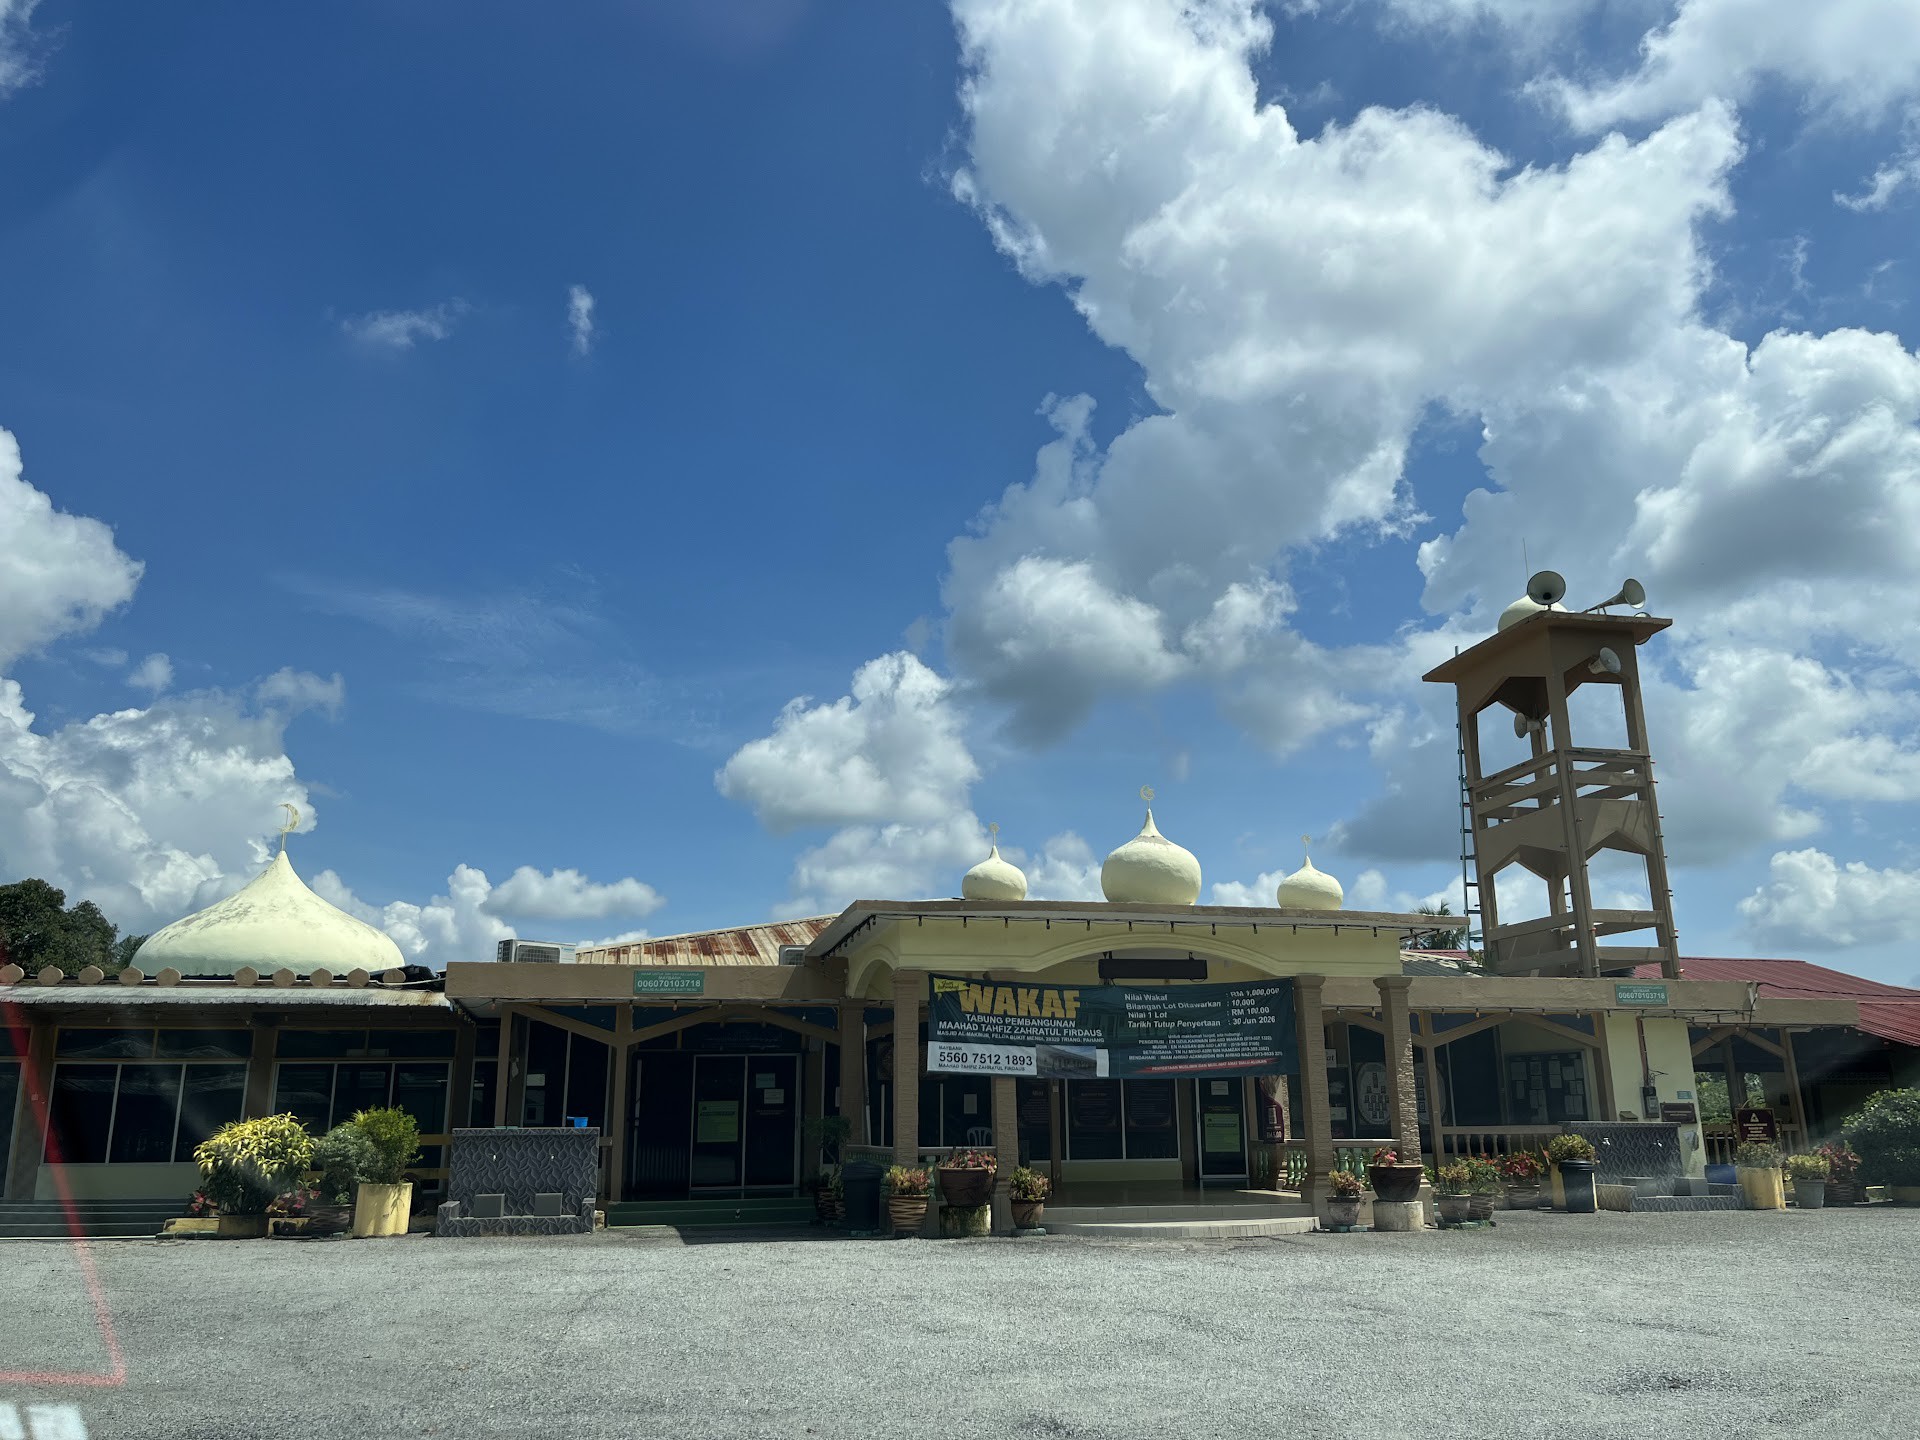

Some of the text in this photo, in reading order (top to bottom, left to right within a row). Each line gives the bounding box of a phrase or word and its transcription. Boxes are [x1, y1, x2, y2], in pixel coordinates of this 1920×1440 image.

[958, 983, 1081, 1018] WAKAF
[966, 1014, 1076, 1028] TABUNG PEMBANGUNAN
[1154, 1021, 1175, 1029] Tutup
[1177, 1019, 1221, 1028] Penyertaan
[939, 1021, 1103, 1037] MAAHAD TAHFIZ ZAHRATUL FIRDAUS
[939, 1052, 1032, 1066] 5560 7512 1893
